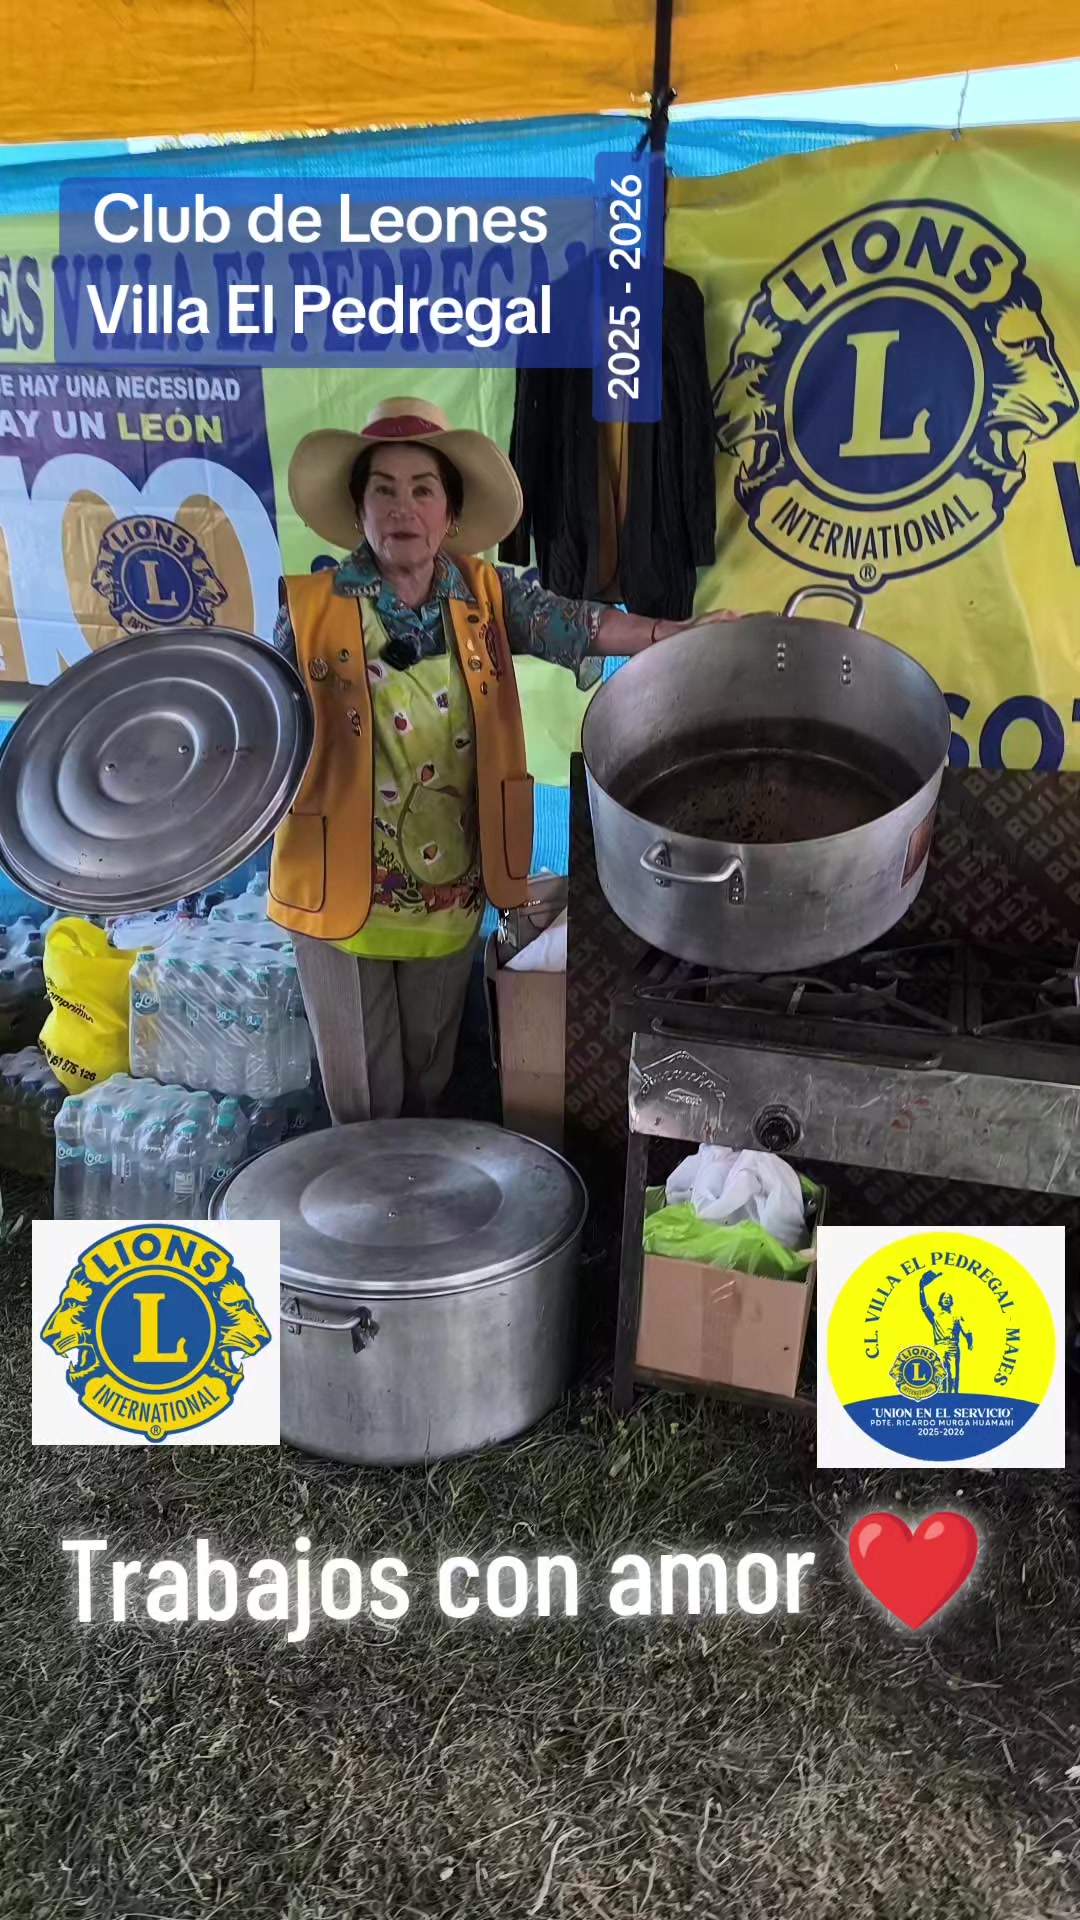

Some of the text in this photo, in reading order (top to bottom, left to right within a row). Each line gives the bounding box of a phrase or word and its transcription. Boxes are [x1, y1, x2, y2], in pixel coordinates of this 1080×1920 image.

[782, 215, 1004, 313] LIONS
[19, 374, 59, 398] HAY
[65, 375, 111, 398] UNA
[115, 376, 241, 402] NECESIDAD
[838, 329, 930, 457] L
[52, 410, 106, 440] UN
[116, 407, 224, 444] LEÓN
[111, 521, 190, 554] LIONS
[771, 493, 980, 561] INTERNATIONAL
[140, 560, 179, 608] L
